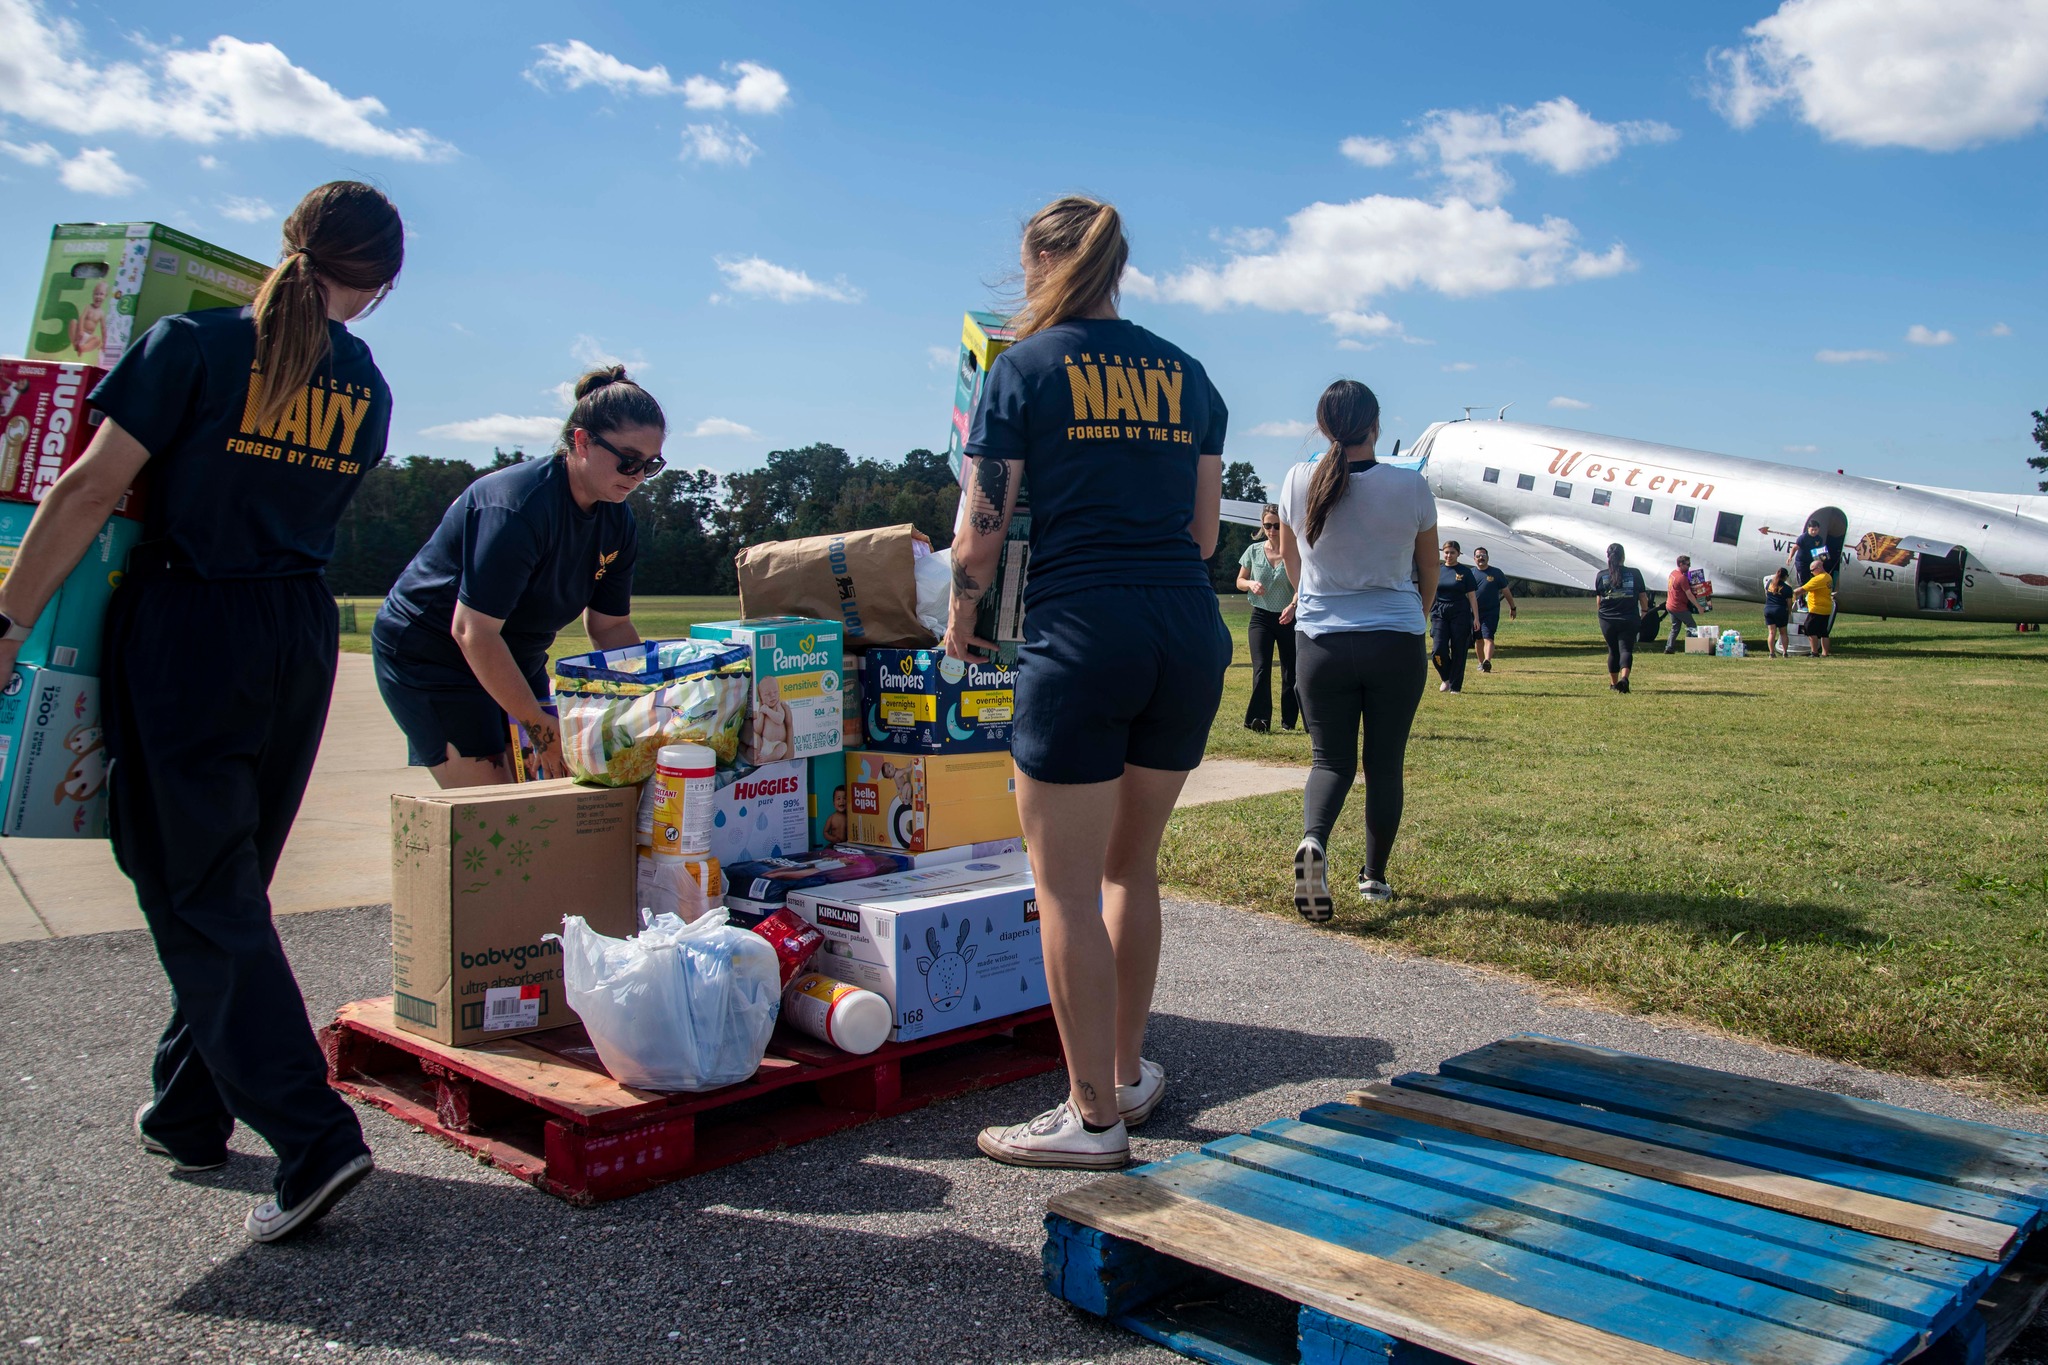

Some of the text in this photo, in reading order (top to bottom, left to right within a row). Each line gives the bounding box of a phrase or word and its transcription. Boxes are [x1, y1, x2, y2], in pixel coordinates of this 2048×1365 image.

[187, 260, 257, 296] DIAPERS
[1064, 353, 1182, 371] AMERICA'S
[251, 359, 371, 399] AICA'S
[1066, 364, 1183, 424] NAVY
[32, 364, 84, 501] HUGGIES
[1067, 426, 1192, 445] FORGED BY THE SEA
[19, 392, 51, 493] little snugglers
[226, 438, 360, 475] FORGED BY THE SEA
[1548, 448, 1715, 501] Western
[1863, 566, 1895, 582] AIR
[829, 536, 865, 638] FOOD LION
[773, 648, 828, 671] Pampers
[880, 665, 924, 692] Pampers
[968, 663, 1019, 688] Pamper
[783, 680, 819, 693] sensitive
[7, 698, 21, 711] NOT
[37, 685, 55, 726] 1200
[886, 699, 915, 710] overnights
[925, 703, 930, 711] 6
[976, 696, 1013, 706] overnights
[0, 711, 15, 724] USH
[814, 708, 825, 716] 504
[794, 732, 827, 745] DO NOT FLUSH
[795, 740, 827, 752] NE PAS JETER
[655, 787, 677, 798] FECTANT
[734, 776, 799, 800] HUGGIES
[854, 787, 876, 799] bello
[654, 796, 665, 804] IPES
[758, 798, 773, 807] pure
[783, 799, 799, 808] 99%
[854, 798, 876, 810] hello
[818, 906, 859, 923] KIRKLAND
[827, 927, 870, 943] couches pañales
[1000, 928, 1030, 941] diapers
[461, 941, 563, 970] babyganic
[977, 957, 993, 967] made
[995, 953, 1018, 963] without
[461, 968, 554, 995] ultra absorbent
[903, 1008, 924, 1025] 168
